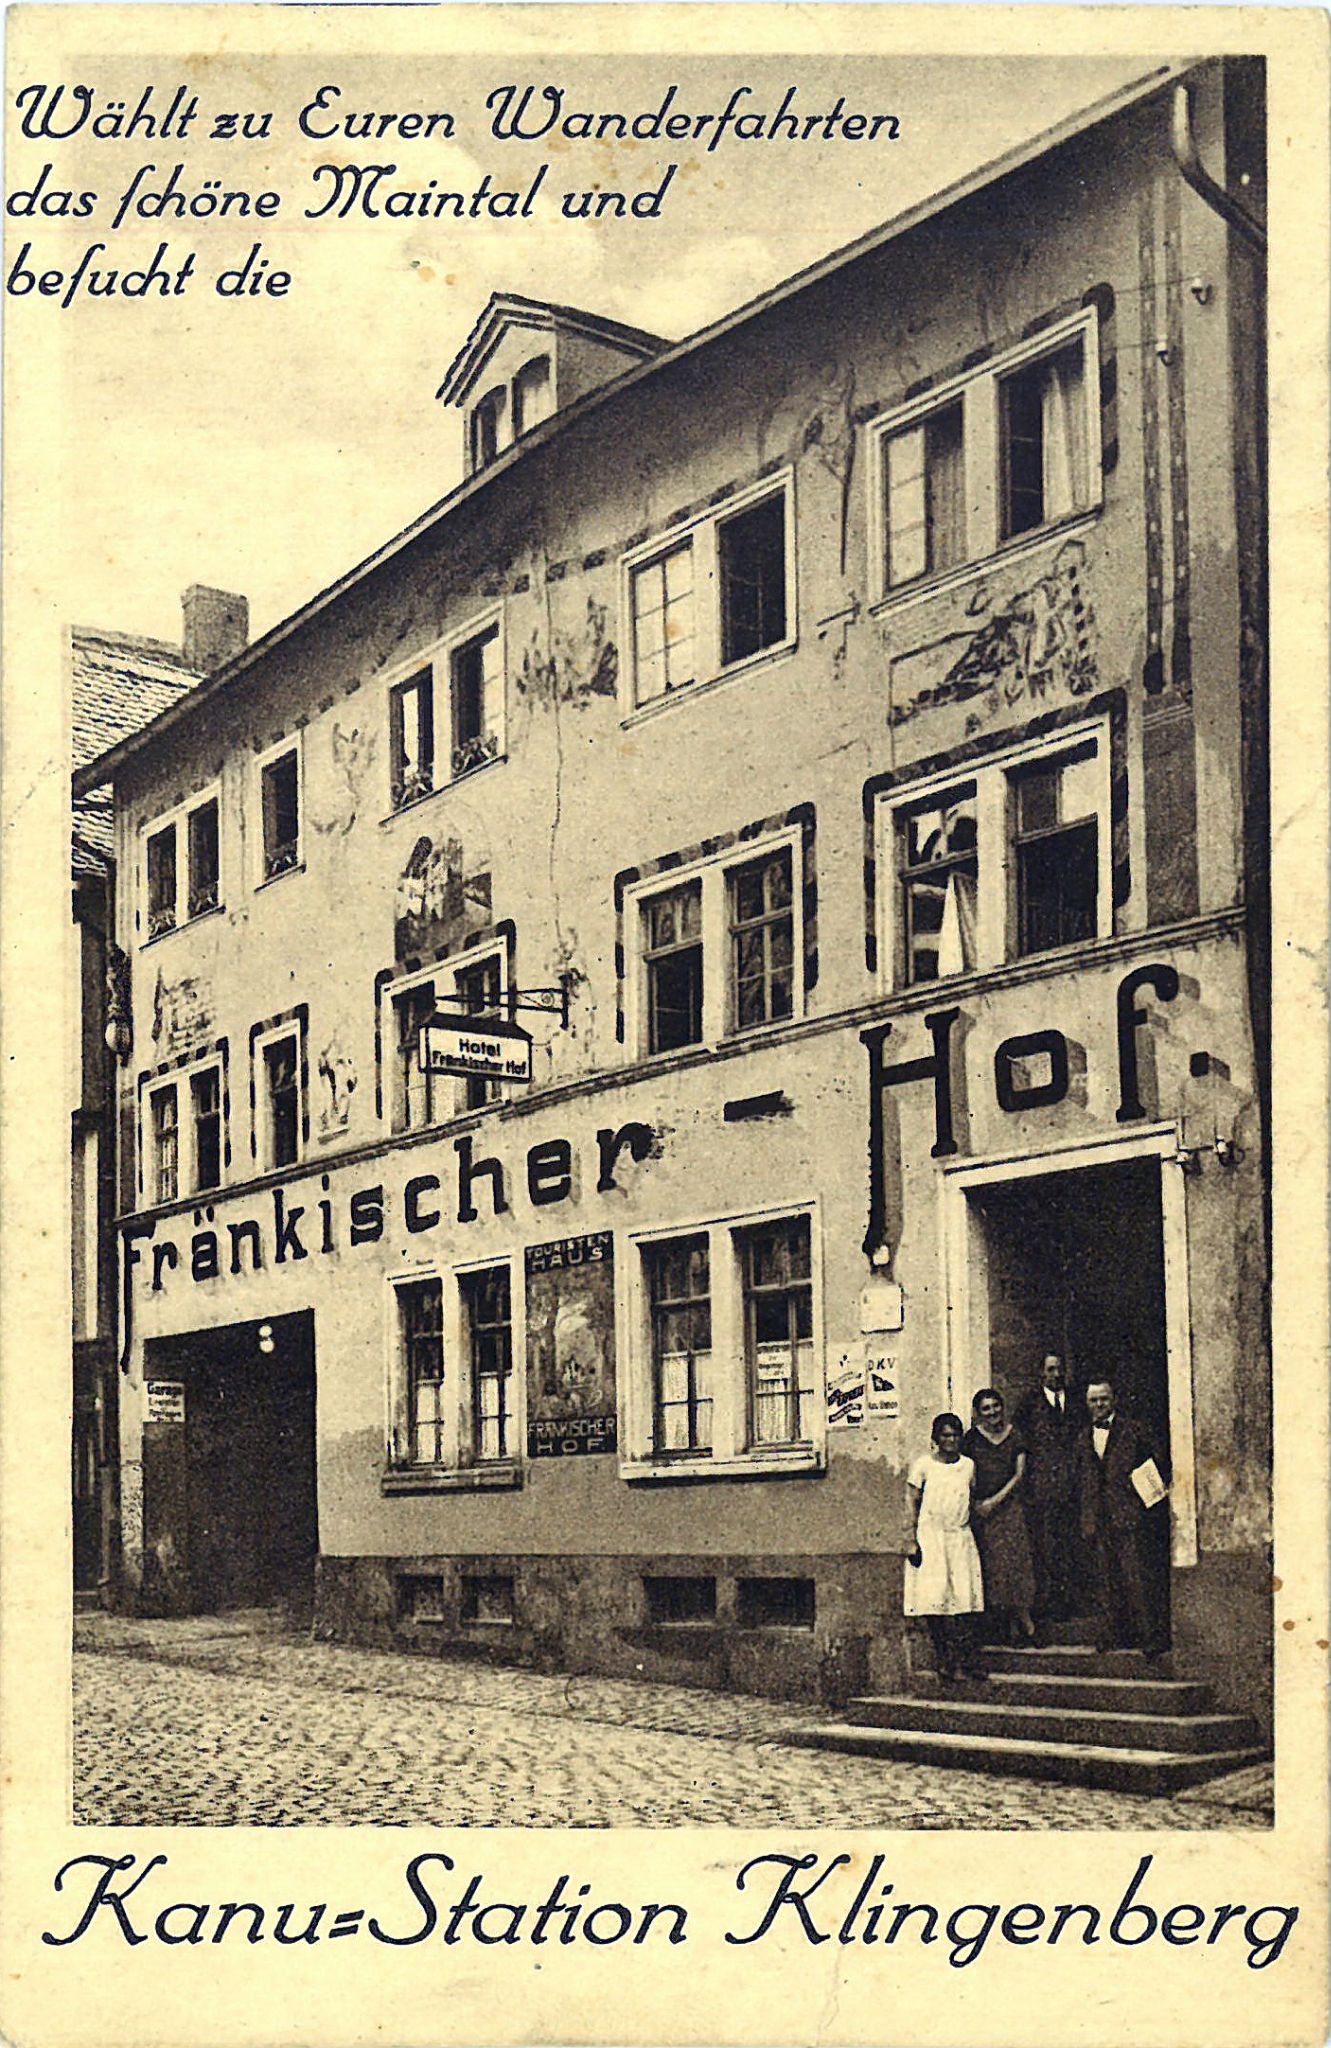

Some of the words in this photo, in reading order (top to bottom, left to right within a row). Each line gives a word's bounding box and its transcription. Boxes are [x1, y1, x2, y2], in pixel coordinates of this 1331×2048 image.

[458, 1038, 501, 1057] Hotel
[505, 1059, 527, 1075] Hof
[121, 1121, 674, 1376] Fränkischer
[525, 1234, 611, 1261] TOURISTEN
[530, 1246, 605, 1273] HAUS
